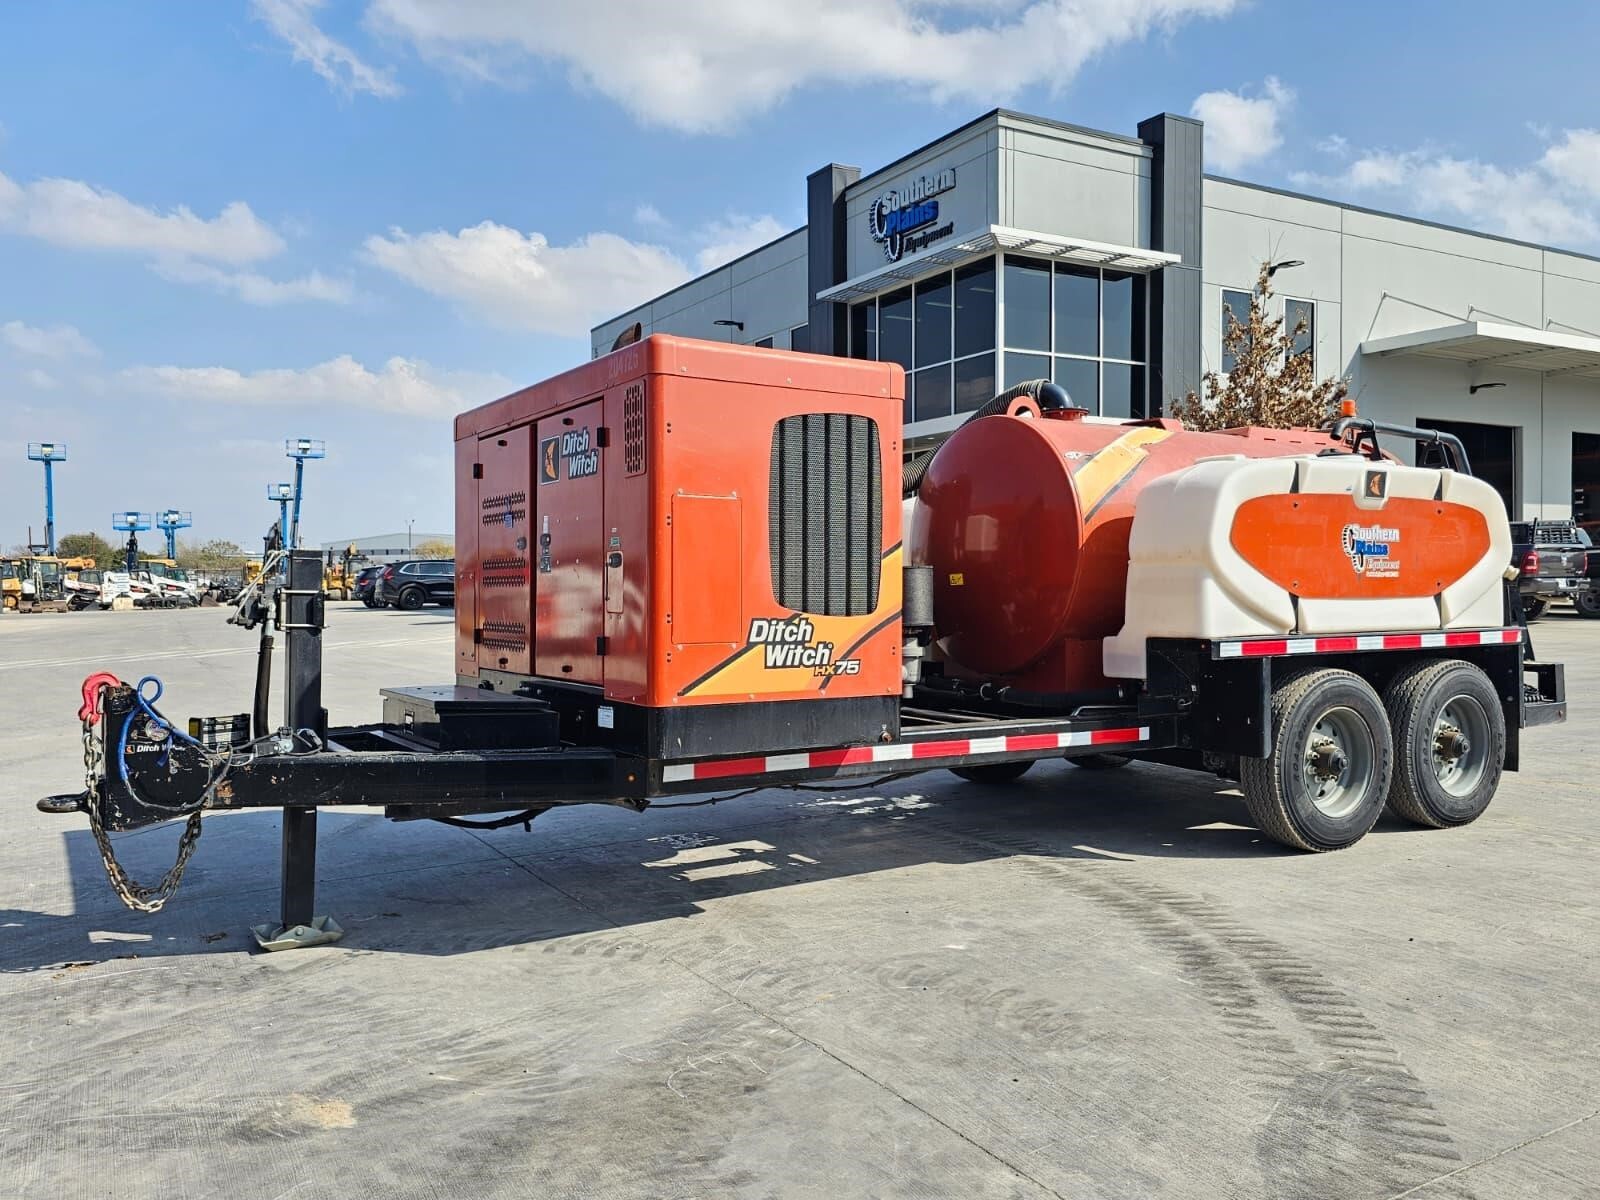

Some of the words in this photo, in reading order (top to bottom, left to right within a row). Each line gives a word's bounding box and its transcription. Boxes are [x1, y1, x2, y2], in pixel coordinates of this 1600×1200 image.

[880, 168, 956, 216] Southern
[886, 200, 939, 238] Plains
[903, 221, 954, 253] Equipment
[562, 427, 590, 457] Ditch
[568, 449, 599, 479] Witch
[1352, 524, 1400, 542] Southern
[1355, 538, 1389, 556] Plains
[748, 618, 813, 643] Ditch
[764, 641, 832, 668] Witch
[814, 659, 860, 676] HX75
[136, 743, 161, 753] Ditch
